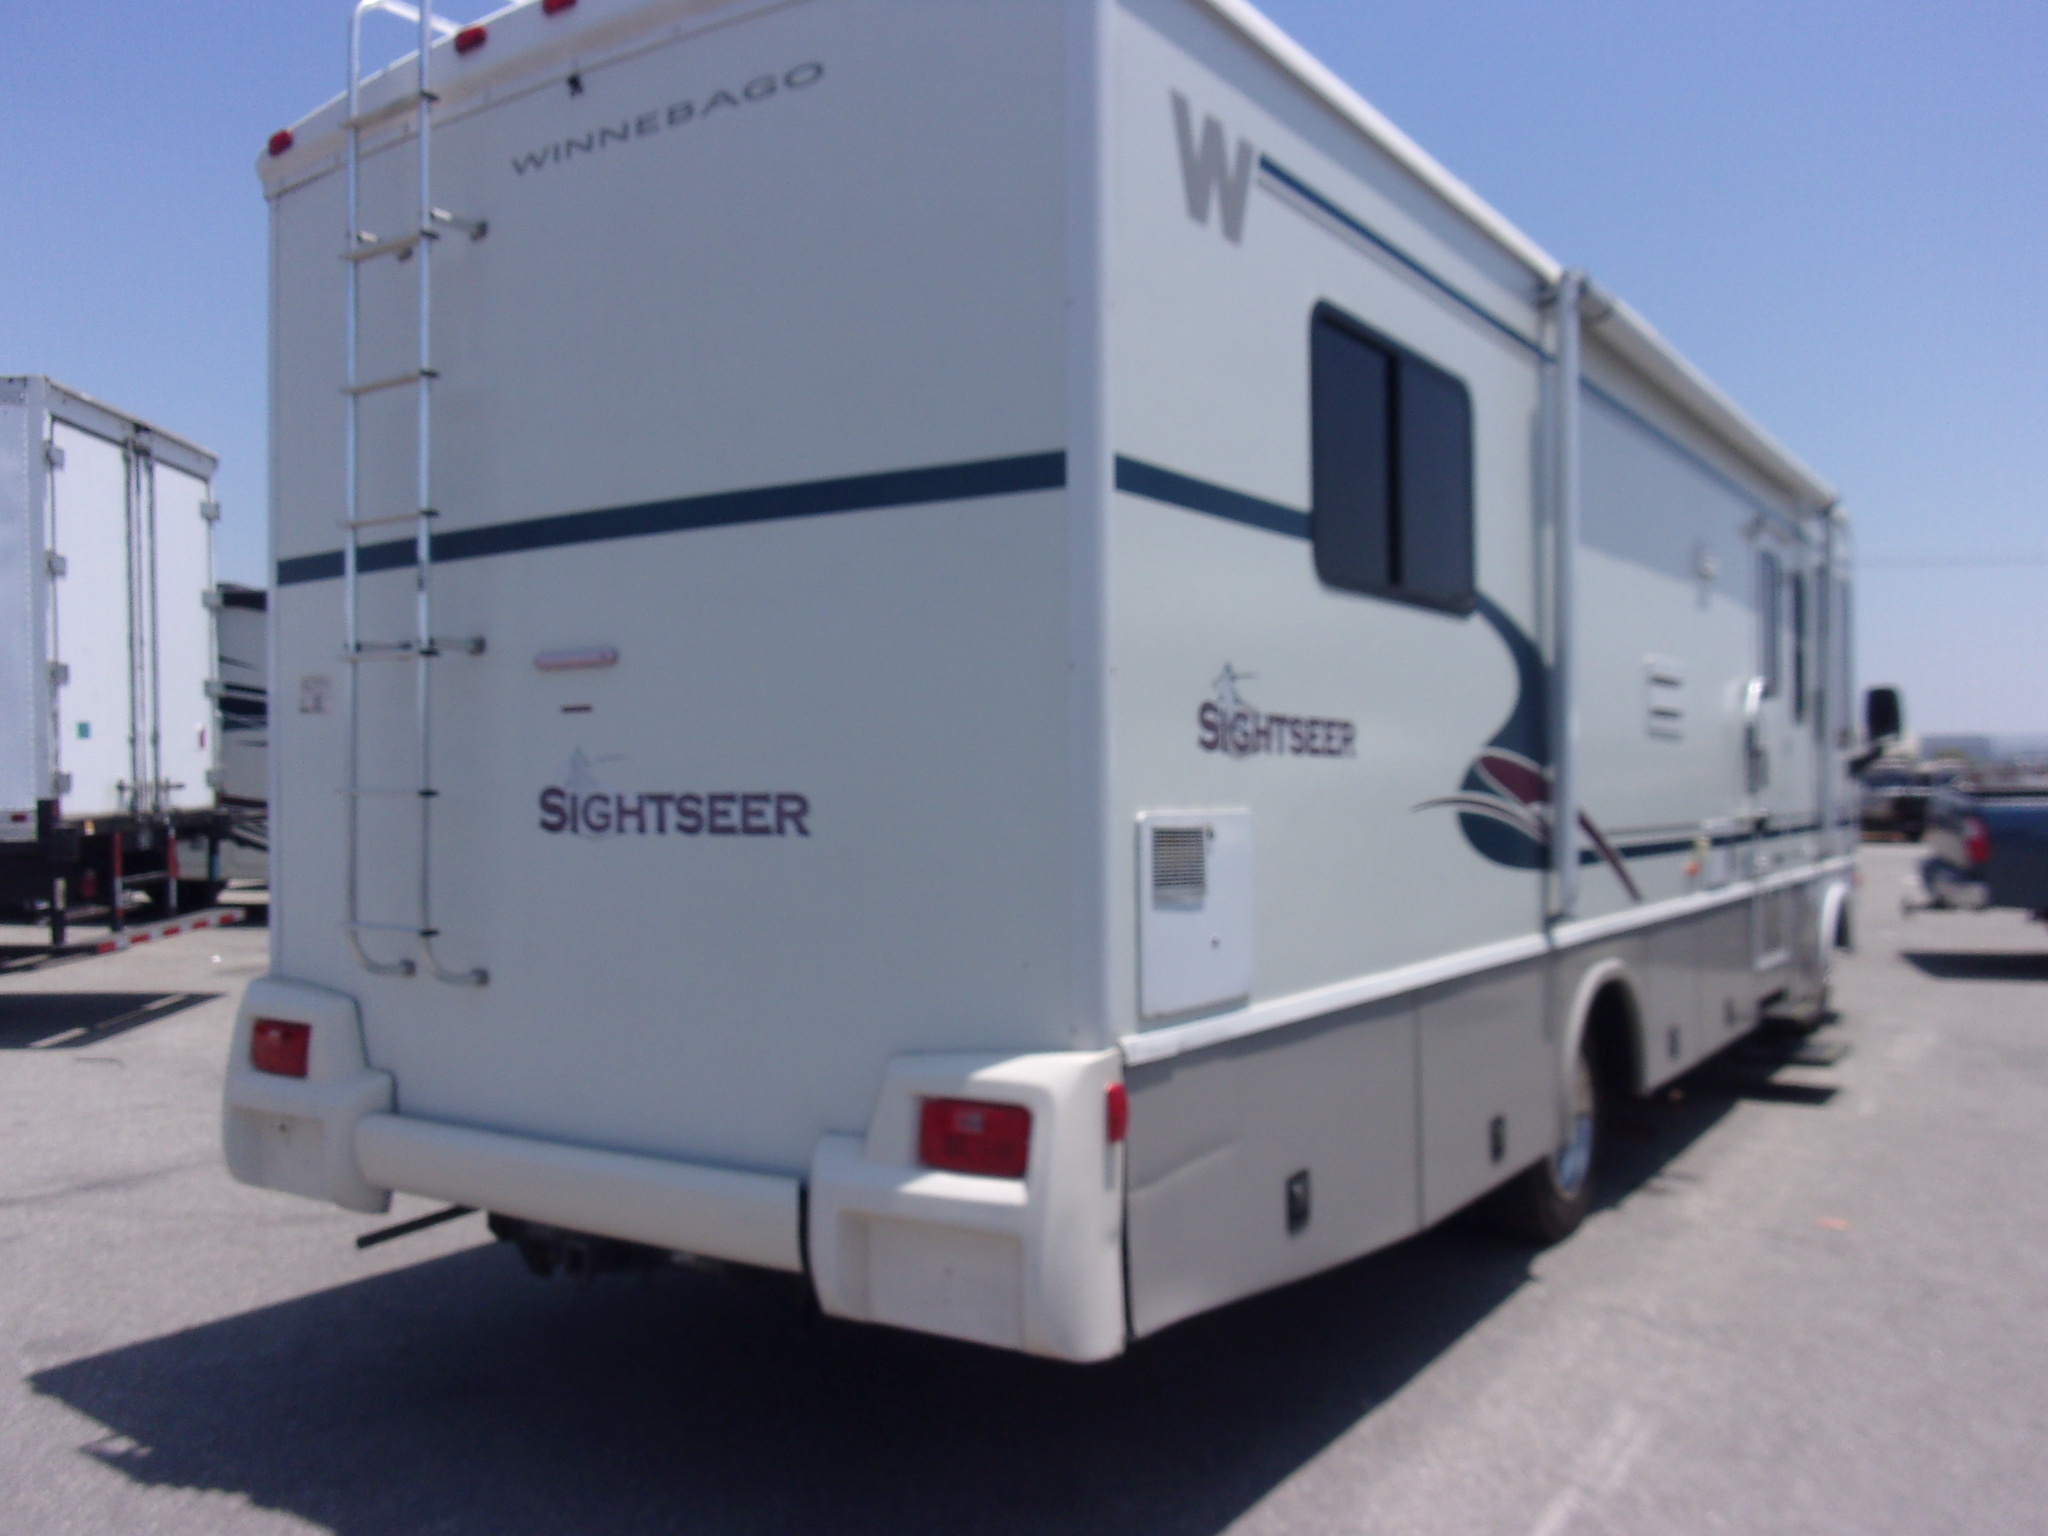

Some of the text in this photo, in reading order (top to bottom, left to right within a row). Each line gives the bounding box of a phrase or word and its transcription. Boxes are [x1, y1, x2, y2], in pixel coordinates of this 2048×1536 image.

[512, 61, 825, 175] WINNEBAGO
[1169, 87, 1253, 243] W
[1198, 699, 1358, 758] SIGHTSEER
[539, 785, 810, 836] SIGHTSEER
